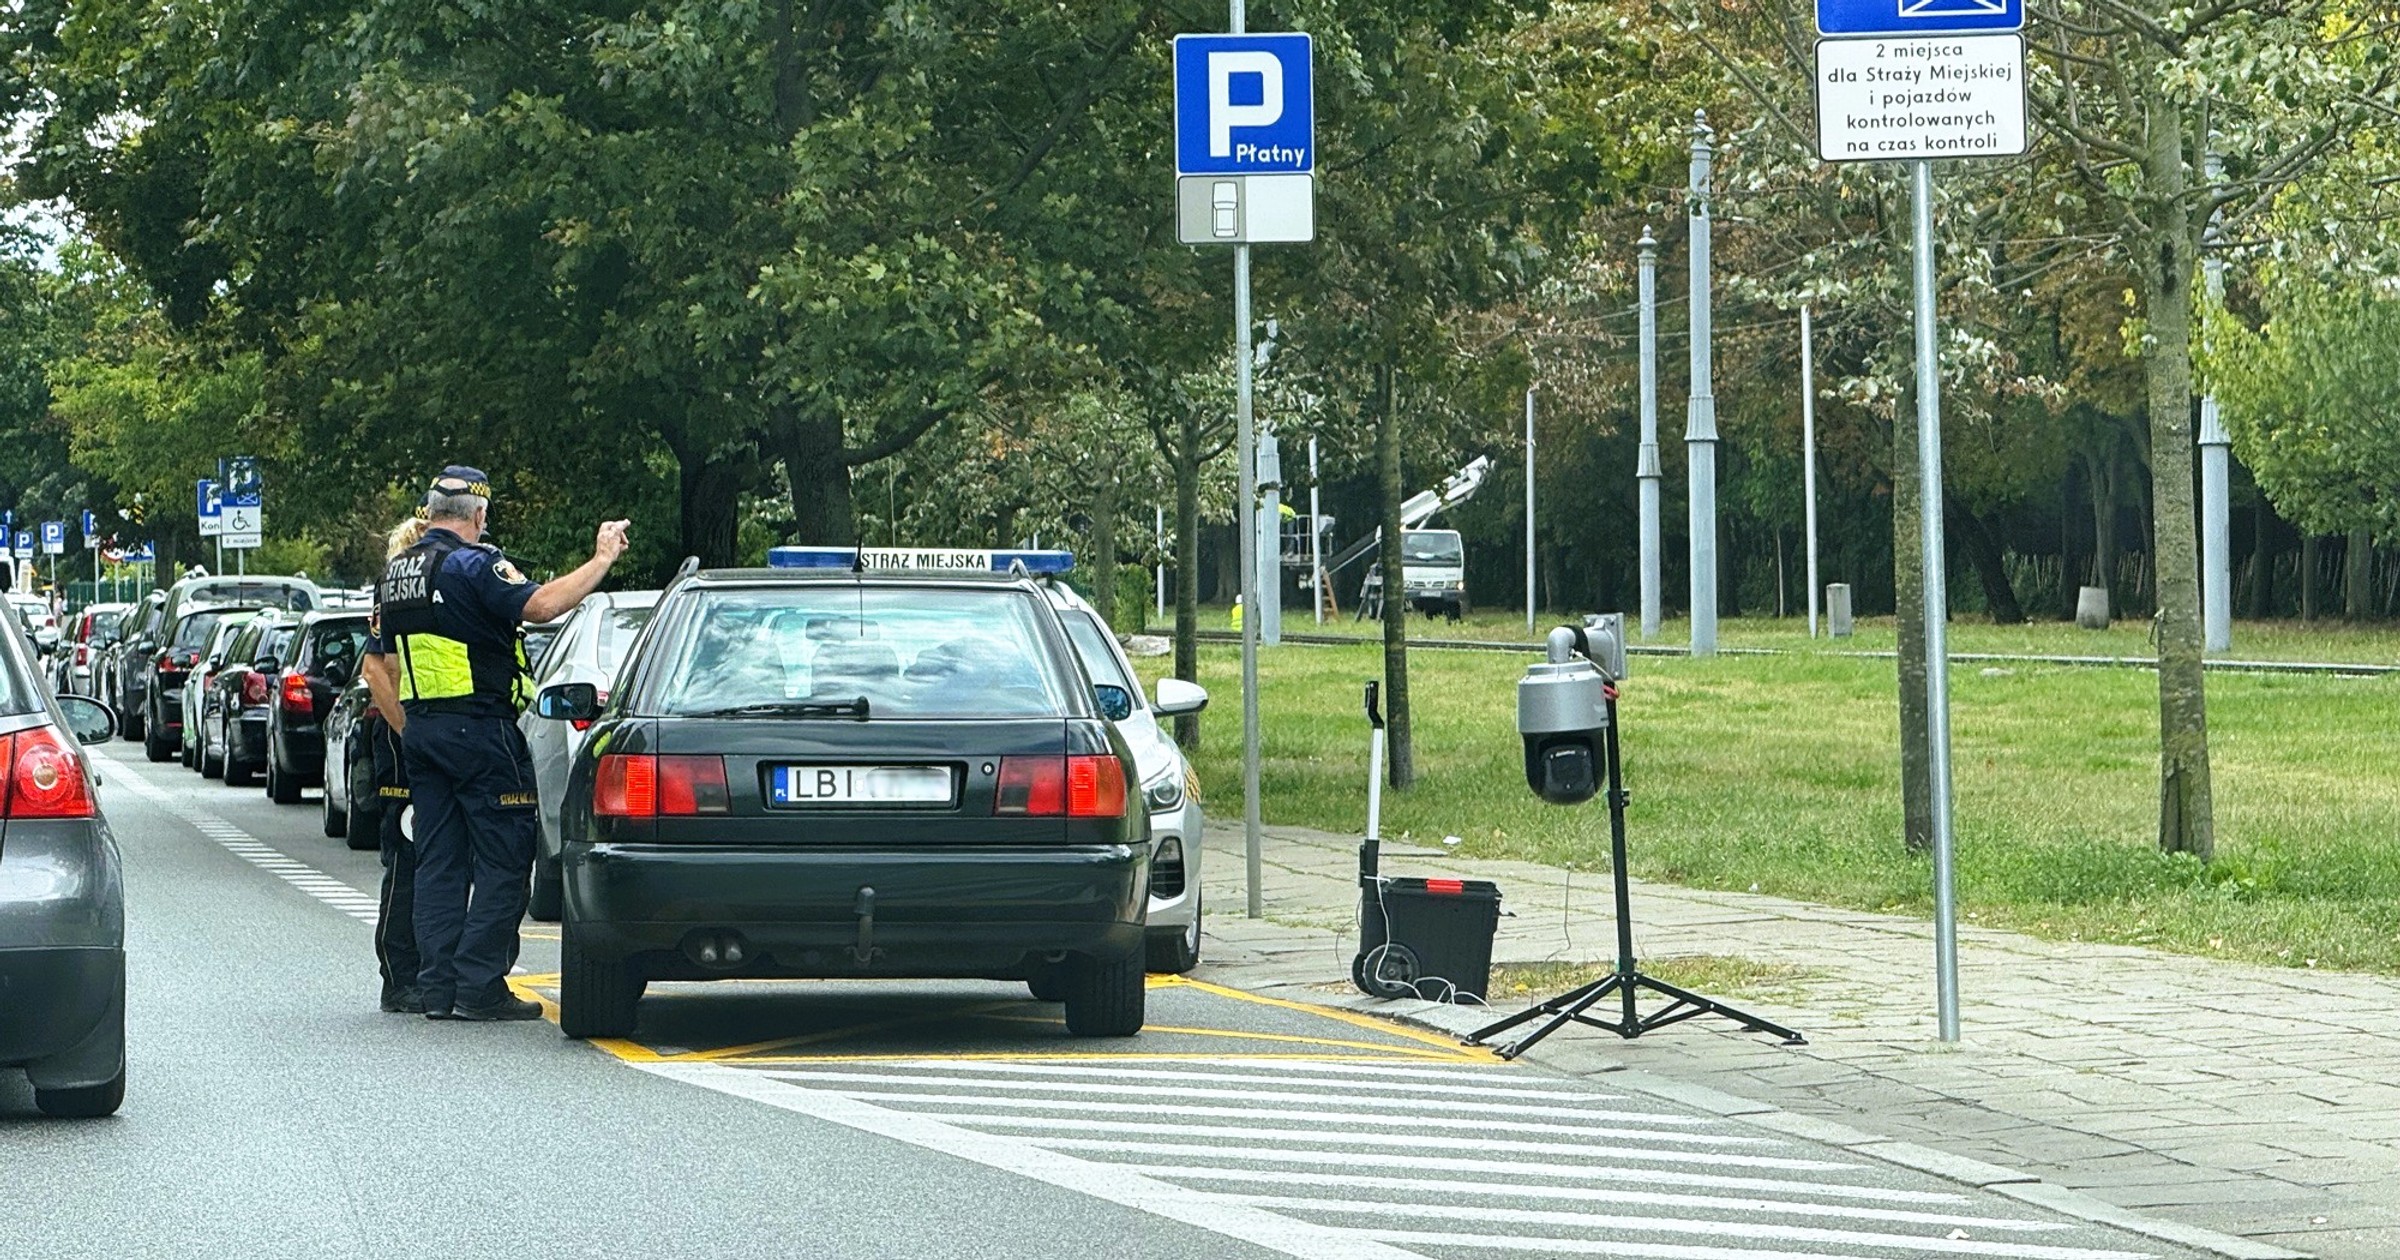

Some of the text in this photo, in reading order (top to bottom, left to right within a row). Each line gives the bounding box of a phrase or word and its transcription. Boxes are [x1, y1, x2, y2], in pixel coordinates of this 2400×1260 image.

[1876, 42, 1963, 61] 2 miejsca
[1828, 62, 2012, 85] dla Straży Miejskiej
[1208, 51, 1284, 157] P
[1869, 87, 1972, 109] i pojazdów
[1847, 110, 1995, 130] kontrolowanych
[1847, 132, 1997, 152] na czas kontroli
[1236, 143, 1305, 168] Płatny
[19, 533, 30, 548] P
[46, 524, 59, 542] P
[386, 552, 427, 581] STRAŻ
[916, 553, 986, 569] MIEJSKA
[775, 789, 787, 797] PL
